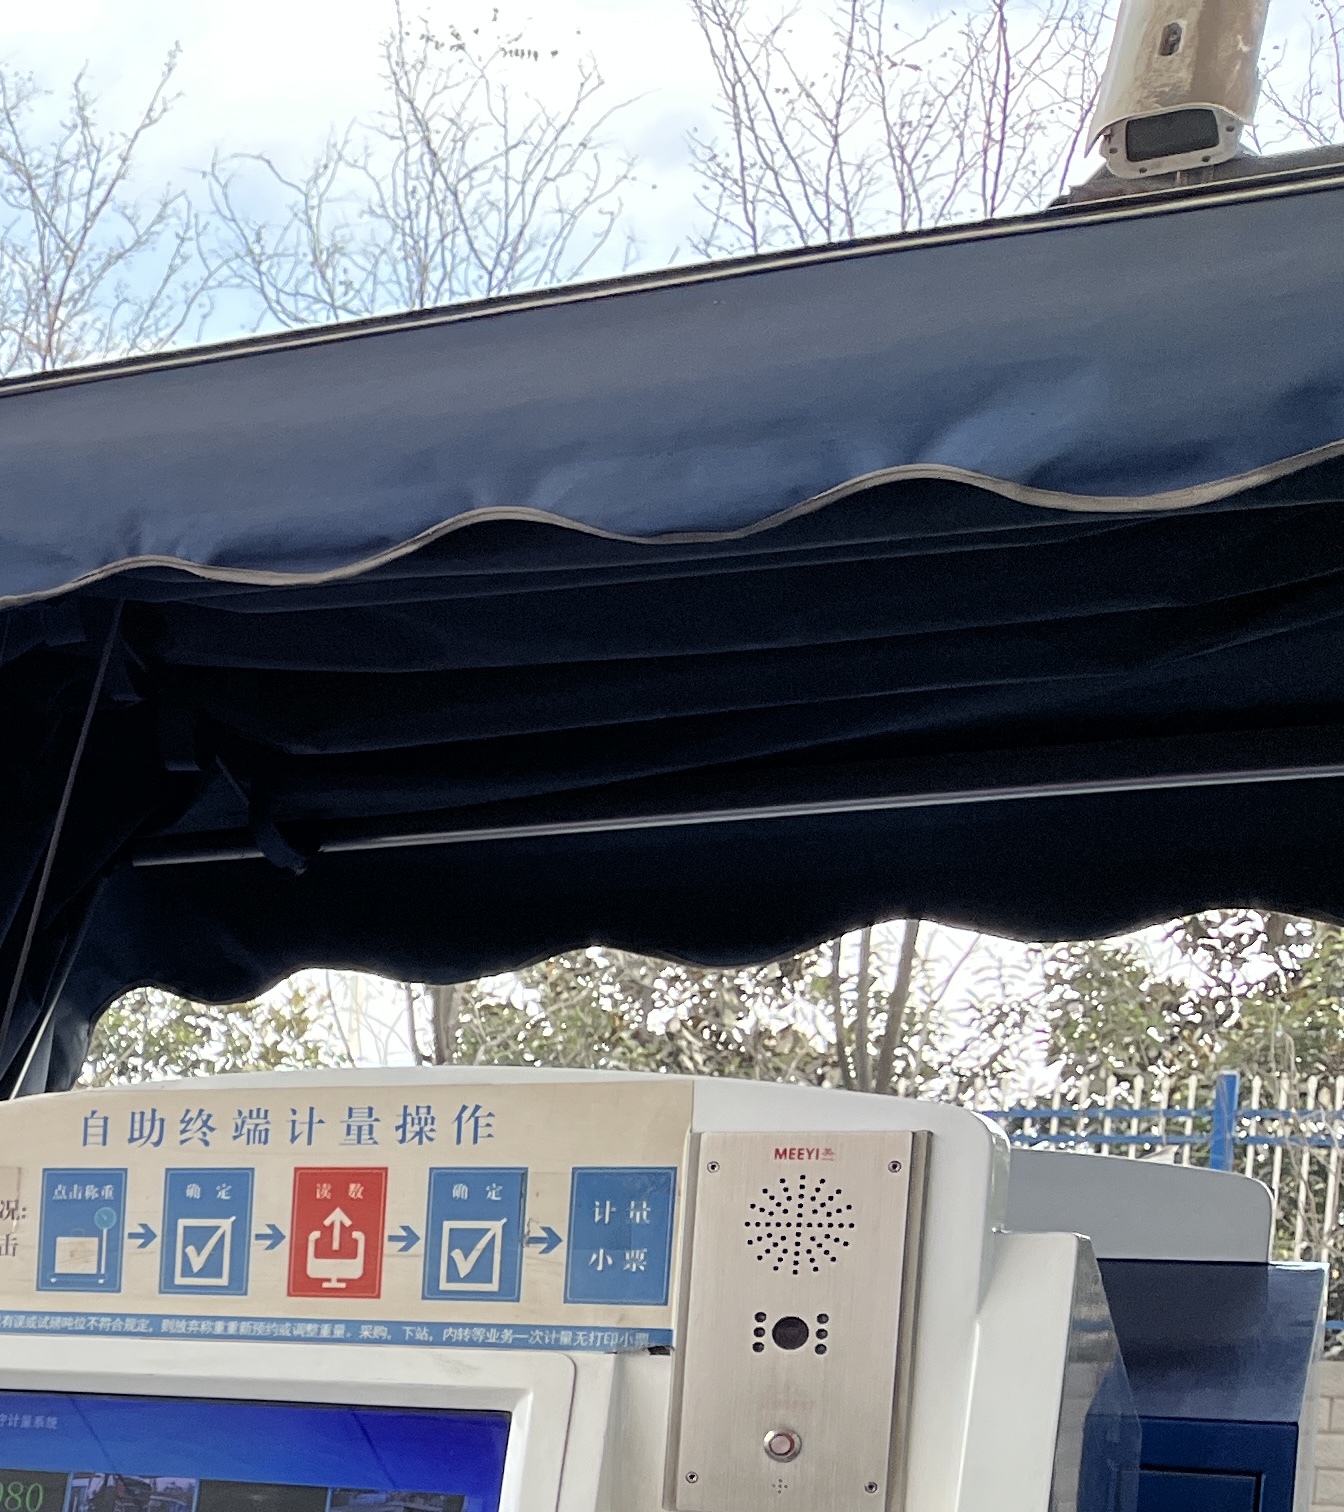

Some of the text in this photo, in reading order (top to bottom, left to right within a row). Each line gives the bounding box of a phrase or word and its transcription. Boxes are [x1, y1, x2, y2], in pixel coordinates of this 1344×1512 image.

[81, 1104, 496, 1148] 自助终端计量操作
[774, 1147, 820, 1161] MEEYI
[52, 1184, 115, 1200] 点击称重
[185, 1183, 232, 1200] 确定
[315, 1183, 365, 1200] 读数
[451, 1183, 504, 1200] 确定
